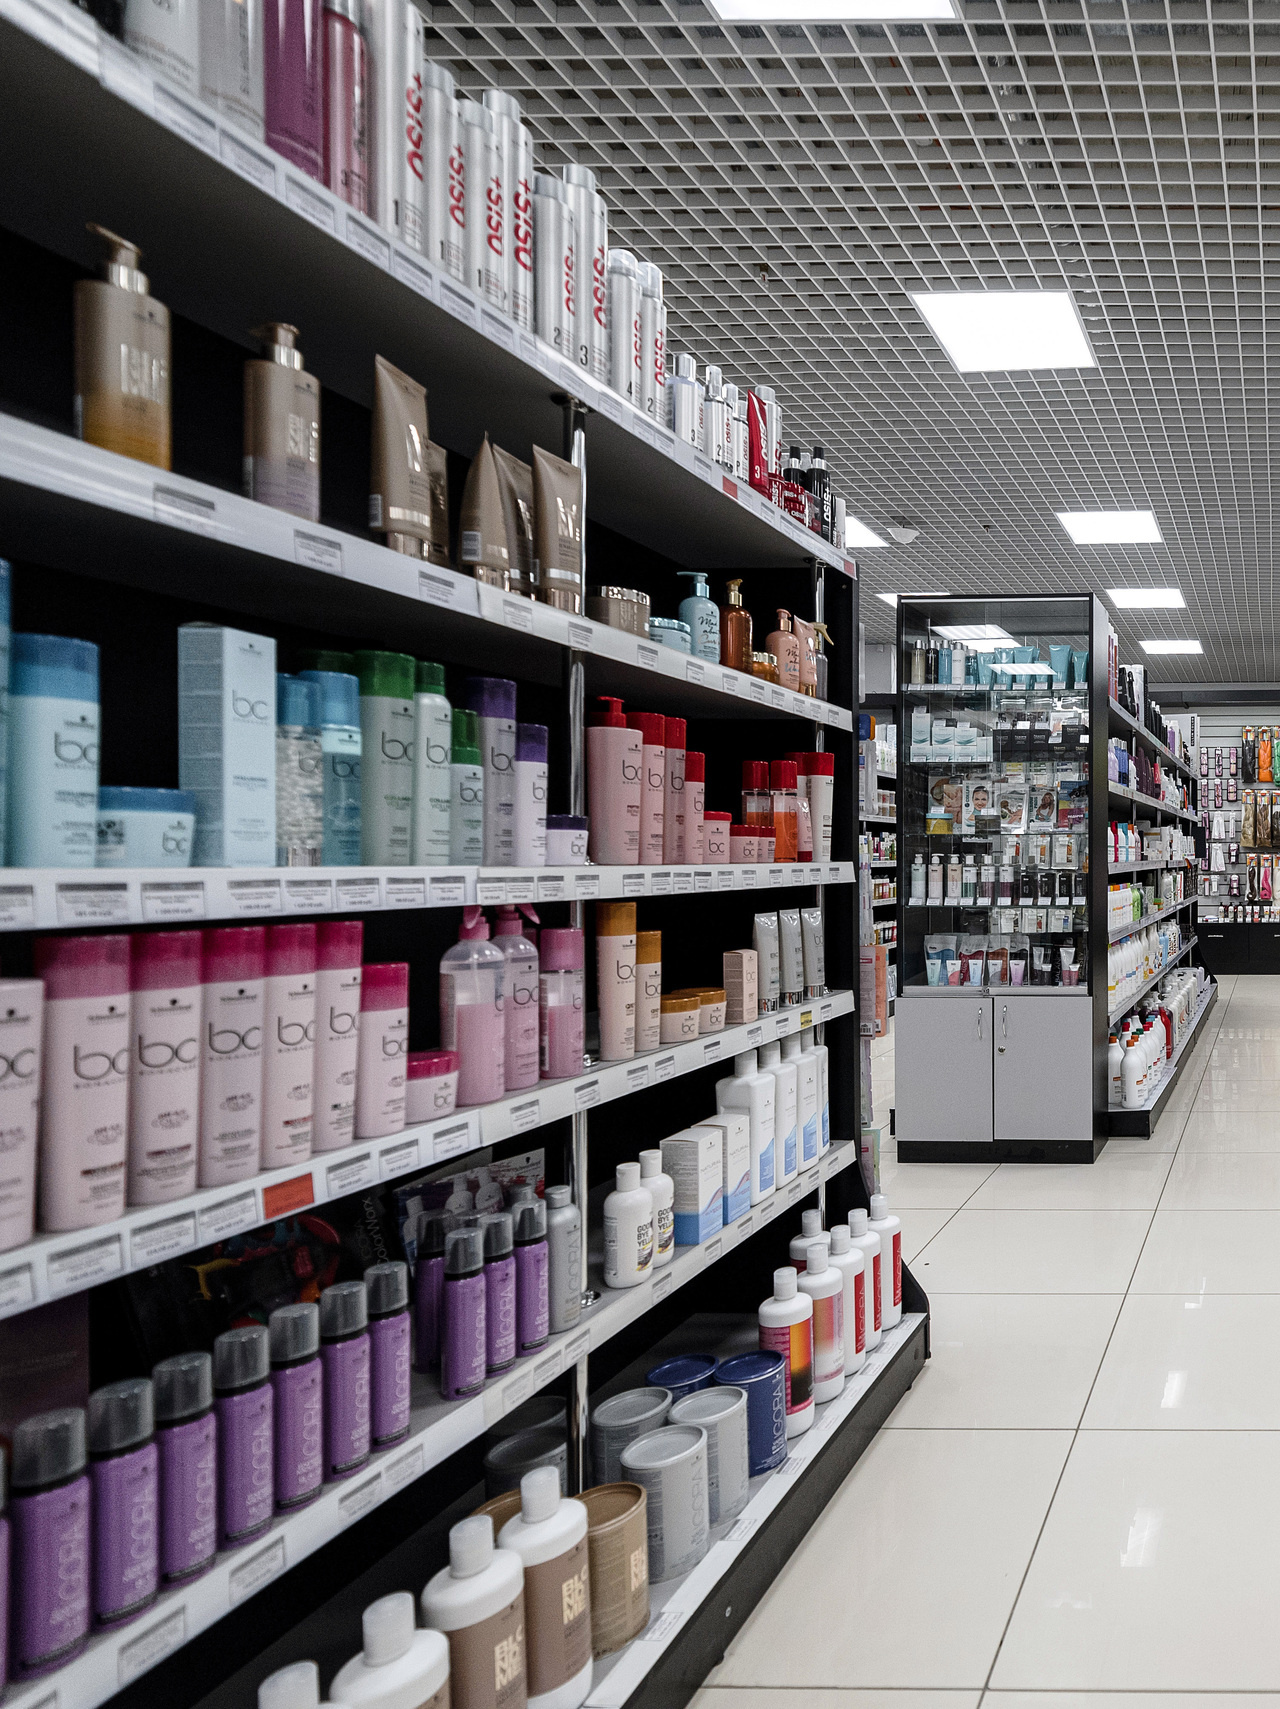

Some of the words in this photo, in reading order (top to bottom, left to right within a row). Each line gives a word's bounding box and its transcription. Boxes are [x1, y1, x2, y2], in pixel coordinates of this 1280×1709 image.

[553, 326, 561, 346] 2
[580, 344, 588, 367] 3
[627, 381, 633, 396] 4
[647, 397, 654, 413] 2
[754, 465, 760, 479] 3
[231, 688, 269, 721] bc
[648, 767, 665, 789] b
[670, 771, 686, 791] b
[532, 781, 548, 801] b
[162, 831, 187, 854] bc
[570, 840, 584, 855] bc
[708, 838, 726, 854] bc
[743, 845, 755, 857] bc
[745, 969, 756, 982] bc
[709, 1012, 723, 1024] bc
[681, 1022, 696, 1034] bc
[208, 1021, 261, 1055] bc
[138, 1033, 197, 1068] bc
[658, 1215, 669, 1225] BYE
[637, 1231, 649, 1240] BYE
